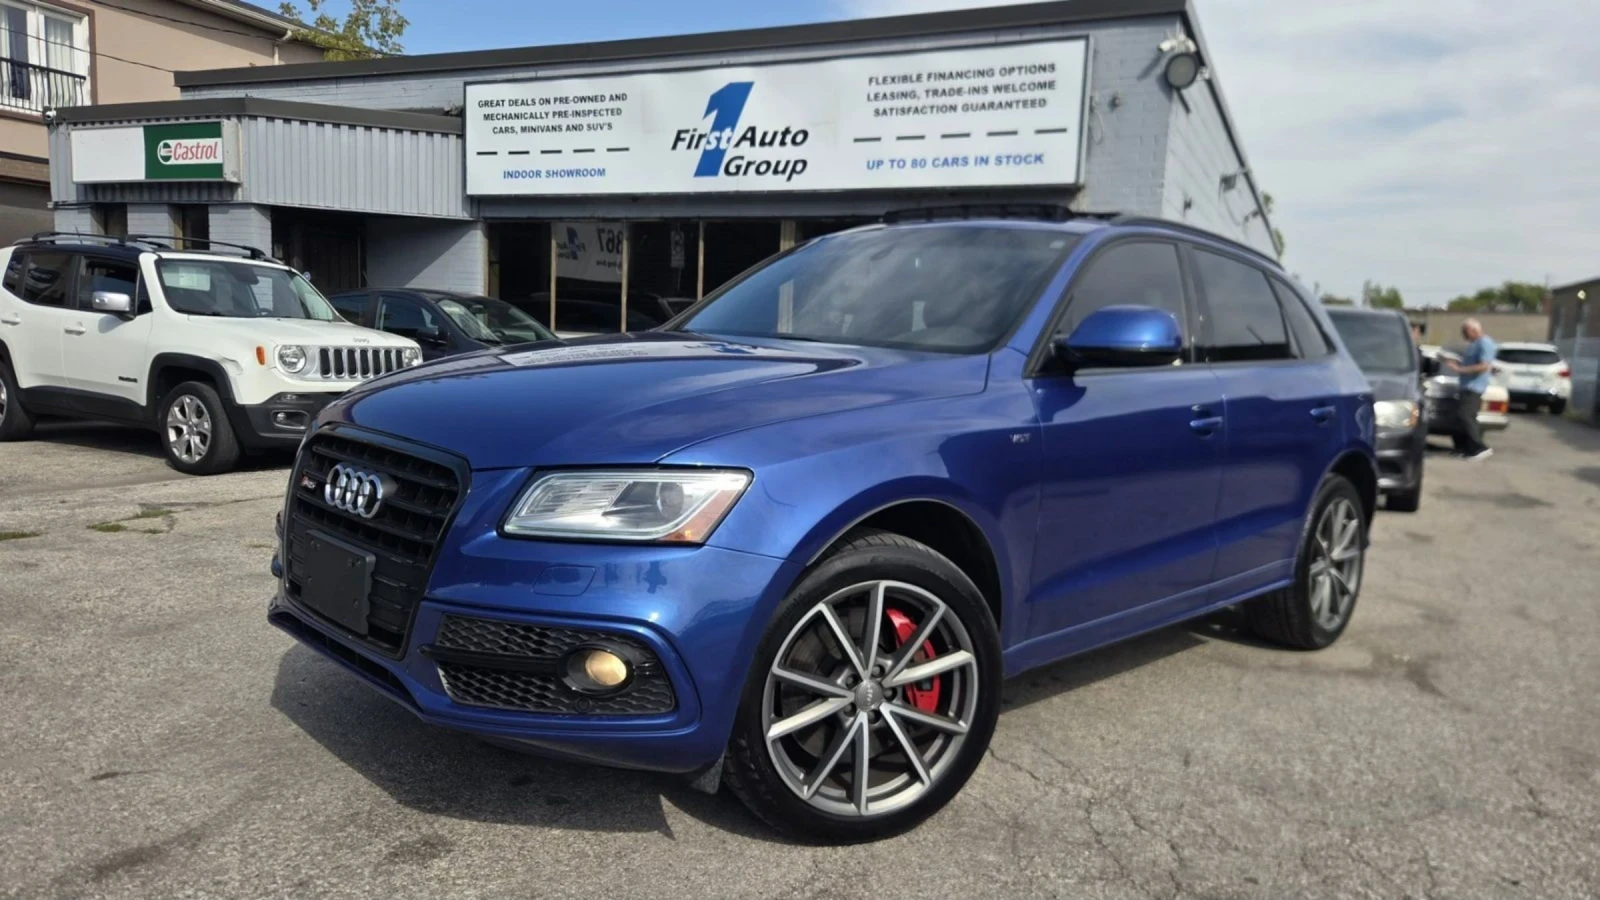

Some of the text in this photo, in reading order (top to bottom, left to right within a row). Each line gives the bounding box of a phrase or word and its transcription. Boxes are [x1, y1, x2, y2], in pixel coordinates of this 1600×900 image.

[868, 63, 1056, 86] FLEXIBLE FINANCING OPTIONS
[867, 80, 1056, 102] LEASING, TRADE-INS WELCOME
[478, 93, 628, 108] GREAT DEALS ON PRE-OWNED AND
[873, 98, 1047, 117] SATISFACTION GUARANTEED
[483, 108, 622, 121] MECHANICALLY PRE-INSPECTED
[492, 122, 613, 135] CARS, MINIVANS AND SUV'S
[671, 126, 809, 151] First Auto
[173, 142, 218, 160] Castrol
[723, 156, 808, 182] Group
[866, 153, 1044, 170] UP TO 80 CARS IN STOCK
[503, 168, 606, 179] INDOOR SHOWROOM
